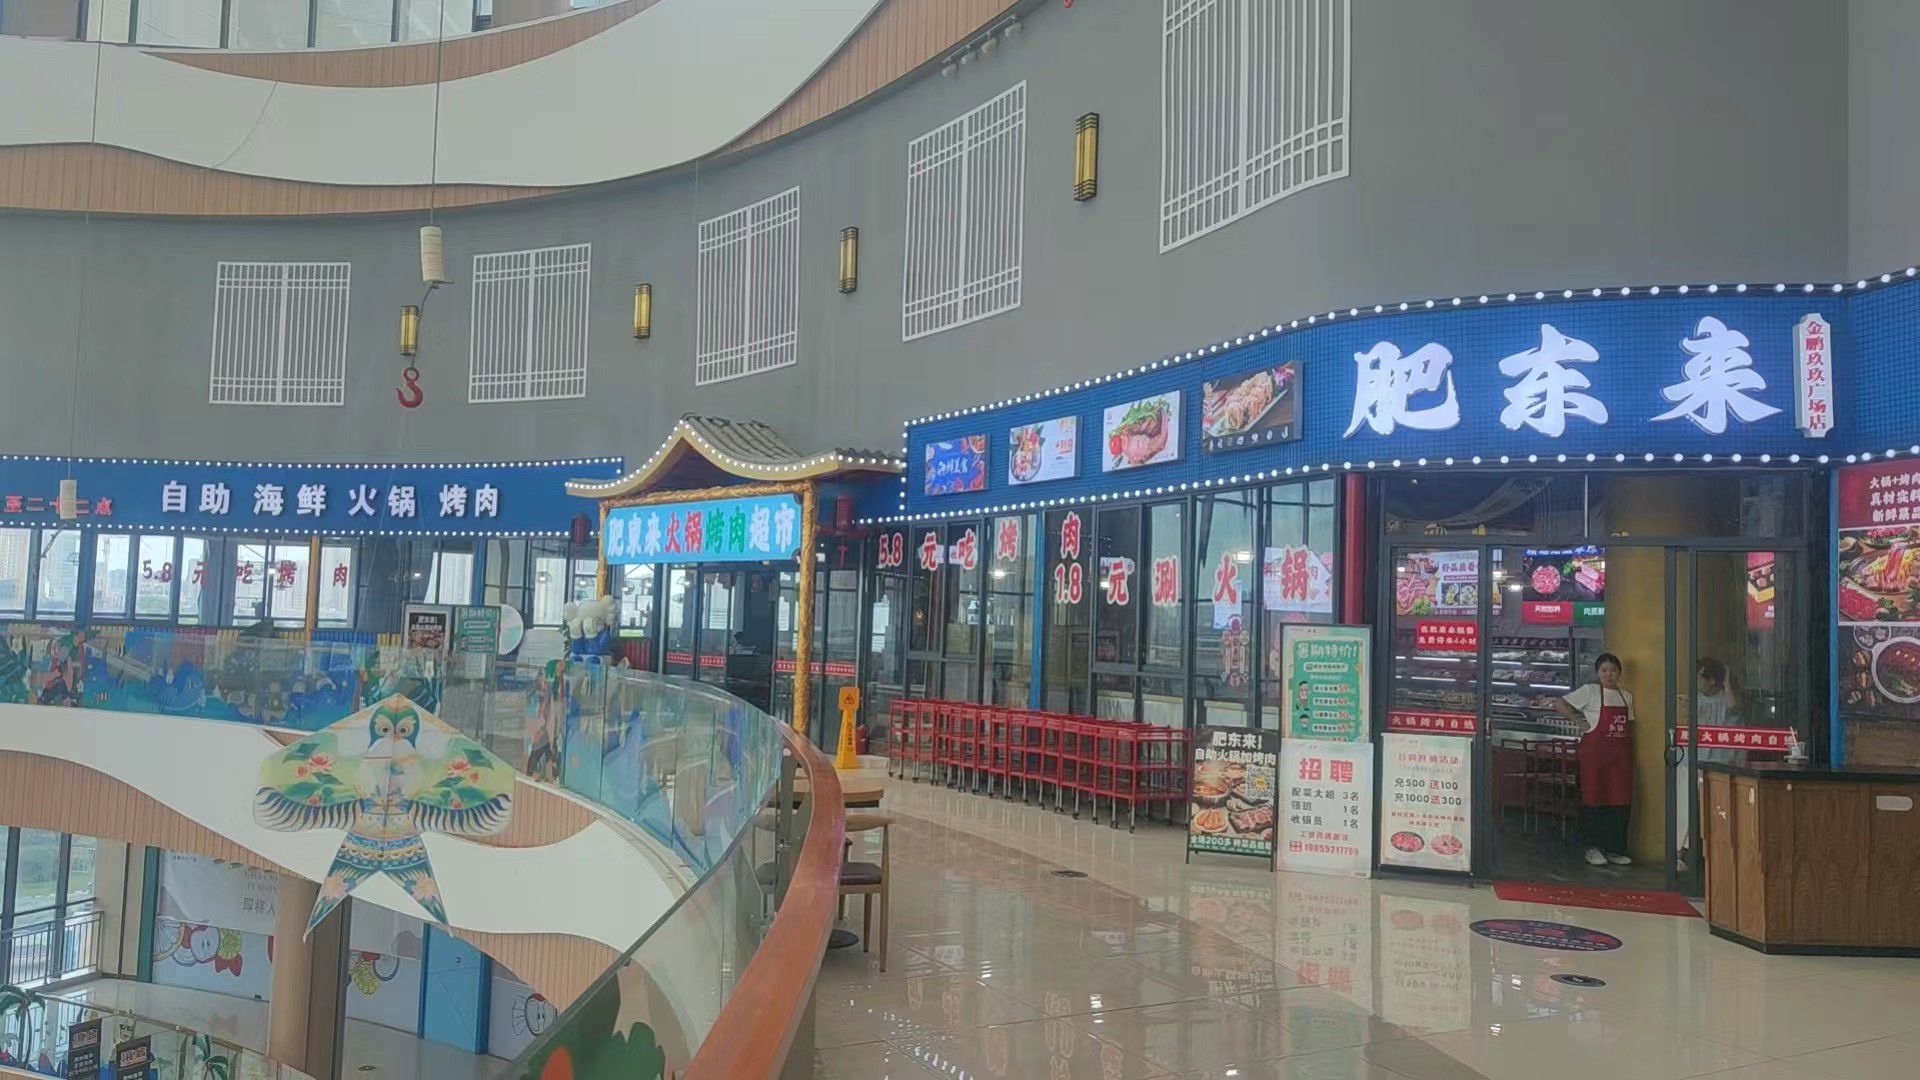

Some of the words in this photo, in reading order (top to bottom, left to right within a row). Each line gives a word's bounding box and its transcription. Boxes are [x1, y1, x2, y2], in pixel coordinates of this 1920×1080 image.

[1343, 314, 1783, 439] 肥东来
[1806, 320, 1826, 430] 金鹏玖玖广场店
[161, 480, 500, 517] 自助海鲜火锅烤肉
[1212, 731, 1262, 750] 肥东来!
[1299, 758, 1353, 783] 招聘
[1291, 787, 1335, 800] 配菜大姐
[1342, 791, 1360, 801] 3名
[1290, 814, 1323, 826] 收银员
